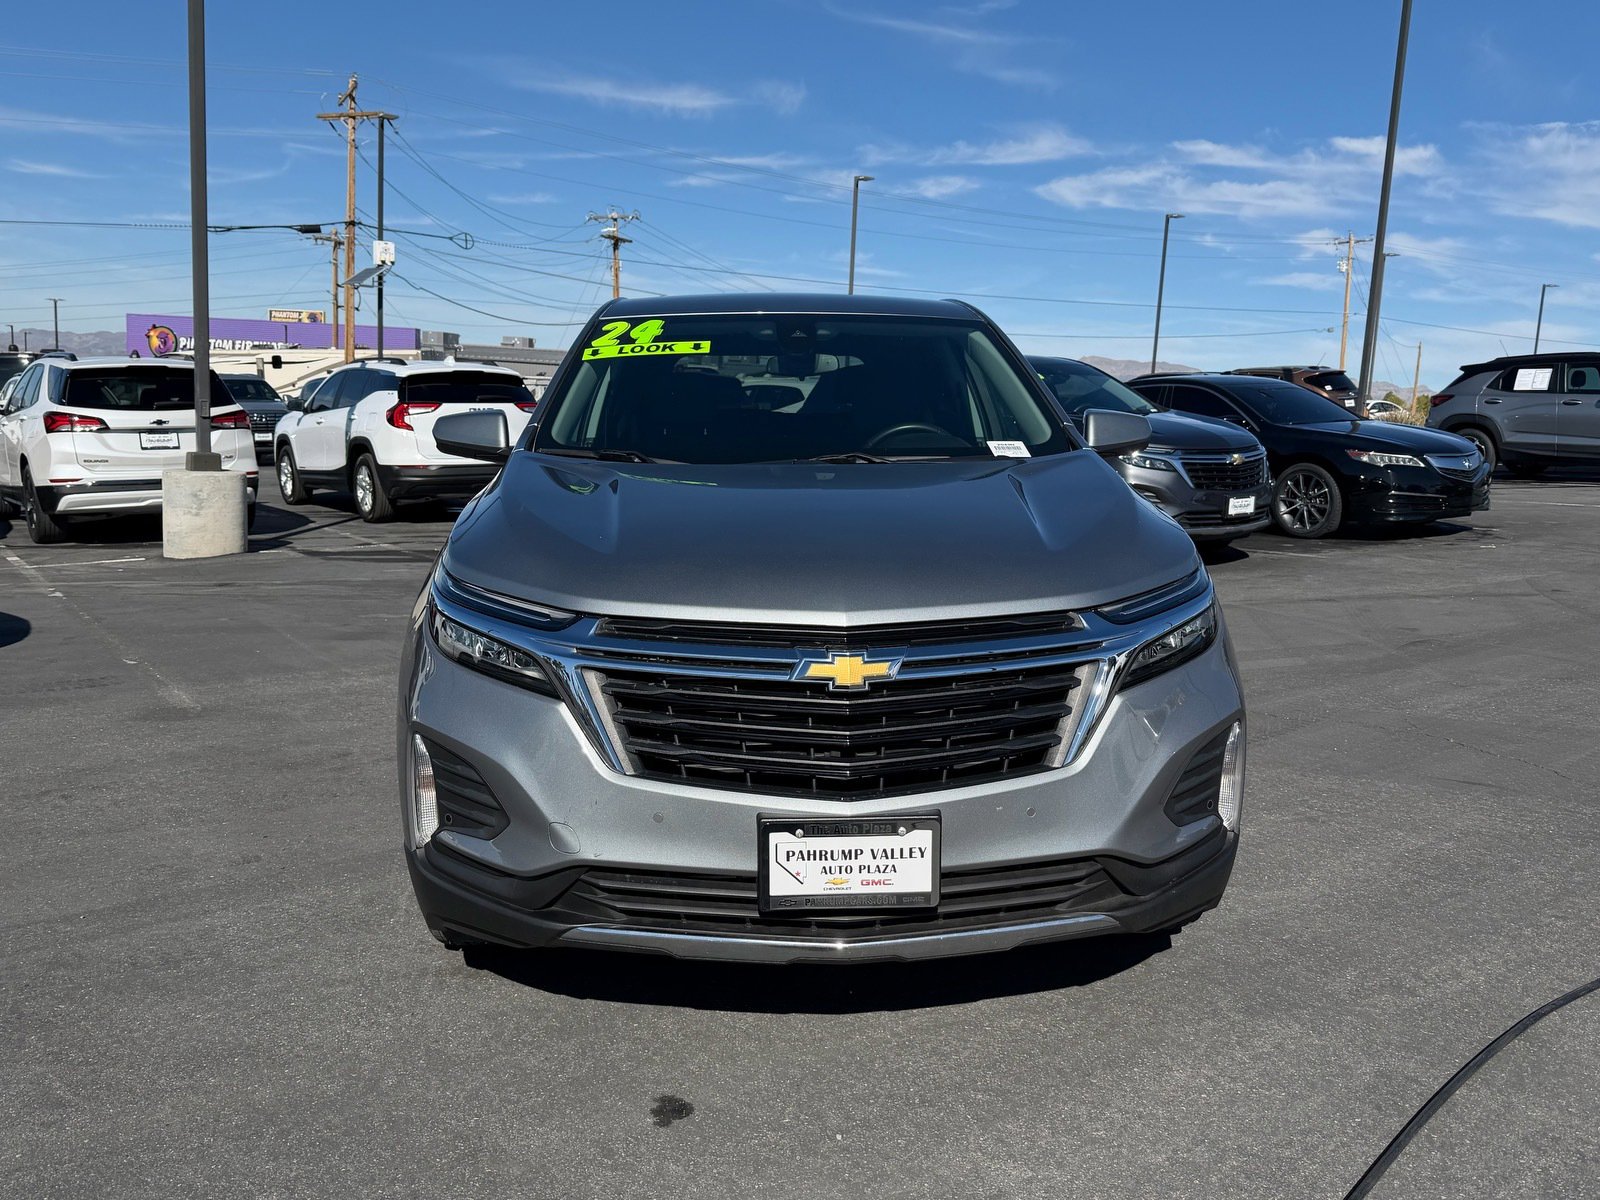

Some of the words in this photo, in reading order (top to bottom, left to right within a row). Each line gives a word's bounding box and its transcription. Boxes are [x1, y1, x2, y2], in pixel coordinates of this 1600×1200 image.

[591, 319, 665, 347] 24
[179, 336, 233, 351] PHTOM
[617, 343, 677, 355] LOOK
[810, 823, 829, 835] The
[834, 823, 859, 835] Auto
[863, 822, 892, 834] Plaza
[786, 848, 864, 862] PAHRUMP
[870, 846, 928, 860] VALLEY
[820, 864, 853, 875] AUTO
[858, 864, 898, 874] PLAZA
